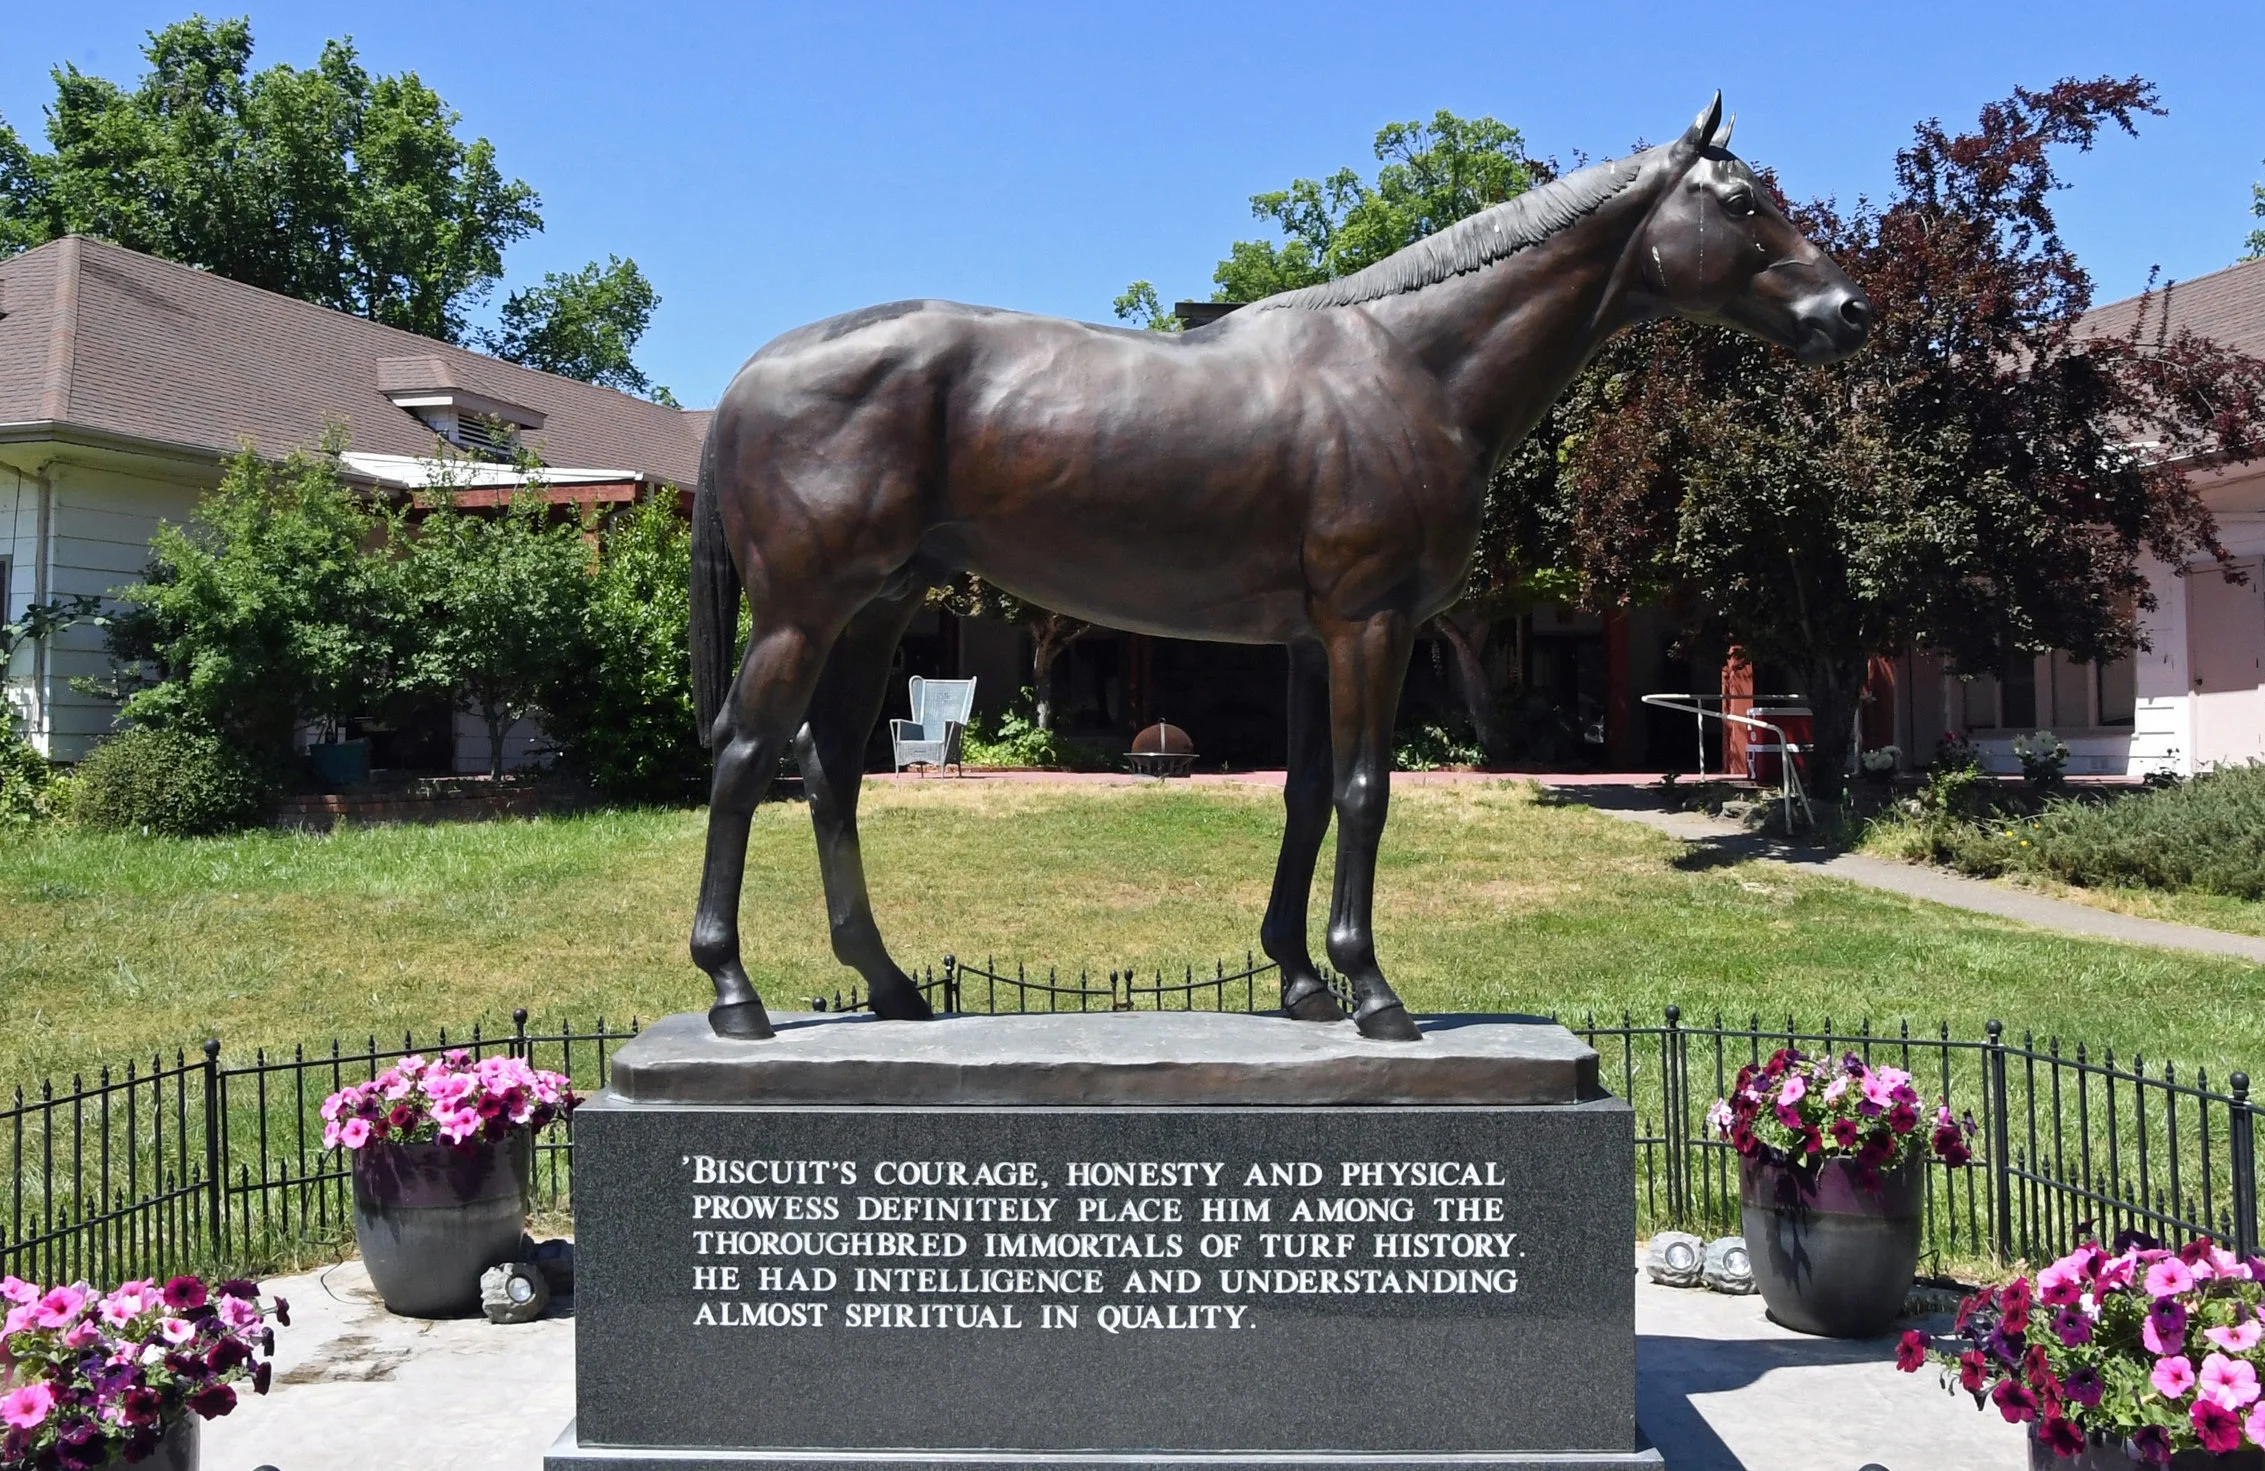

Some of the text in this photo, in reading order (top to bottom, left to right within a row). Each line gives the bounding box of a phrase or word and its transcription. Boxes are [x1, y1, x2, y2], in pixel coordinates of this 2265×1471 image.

[873, 1160, 1049, 1190] COURAGE,
[1065, 1161, 1225, 1187] HONESTY
[1242, 1161, 1323, 1187] AND
[1340, 1161, 1506, 1187] PHYSICAL
[691, 1194, 1505, 1223] PROWESS DEFINITELY PLACE HIM AMONG THE
[692, 1230, 1526, 1259] THOROUGHBRED IMMORTALS OF TURF HISTORY.
[692, 1265, 1519, 1295] HE HAD INTELLIGENCE AND UNDERSTANDING
[692, 1301, 1257, 1335] ALMOST SPIRITUAL IN QUALITY.
